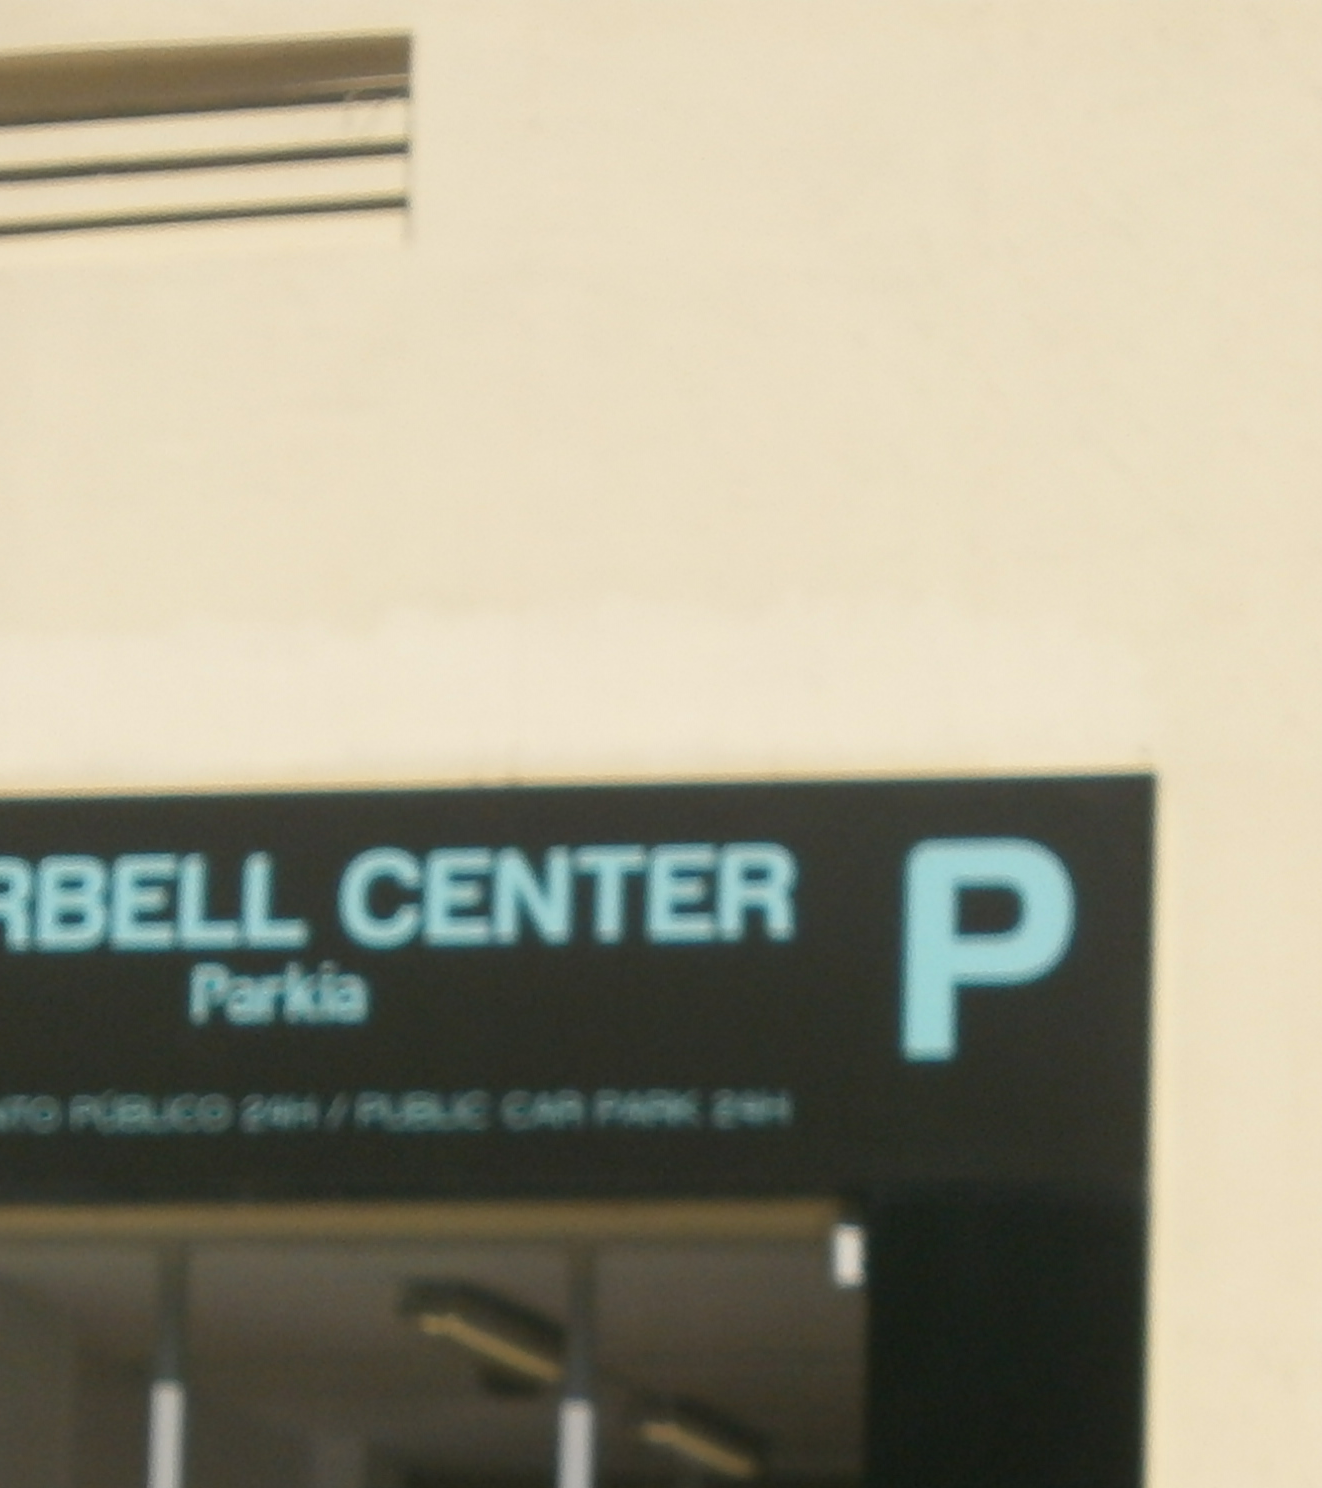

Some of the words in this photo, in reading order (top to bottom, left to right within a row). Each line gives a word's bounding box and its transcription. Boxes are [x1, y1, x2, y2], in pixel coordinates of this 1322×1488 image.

[337, 842, 798, 950] CENTER
[901, 838, 1077, 1062] P
[189, 961, 369, 1026] Parkia
[354, 1092, 492, 1132] PUBLIC
[501, 1091, 584, 1131] CAR
[592, 1090, 700, 1130] PARK
